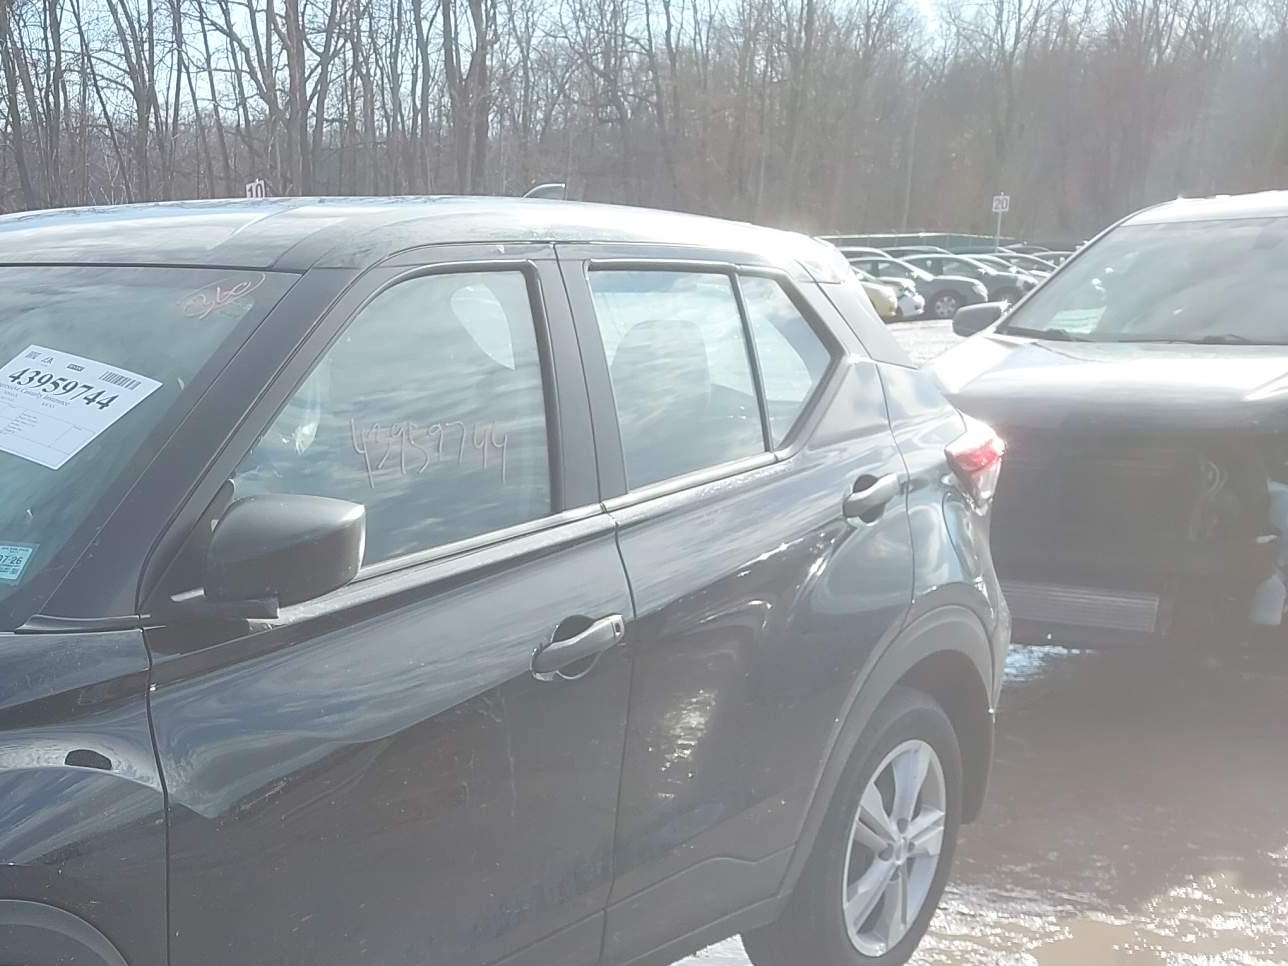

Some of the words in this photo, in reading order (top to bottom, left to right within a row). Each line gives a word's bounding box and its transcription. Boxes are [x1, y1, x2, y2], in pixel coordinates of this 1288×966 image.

[248, 184, 263, 198] 10
[994, 198, 1008, 210] 20
[8, 368, 119, 410] 43959744
